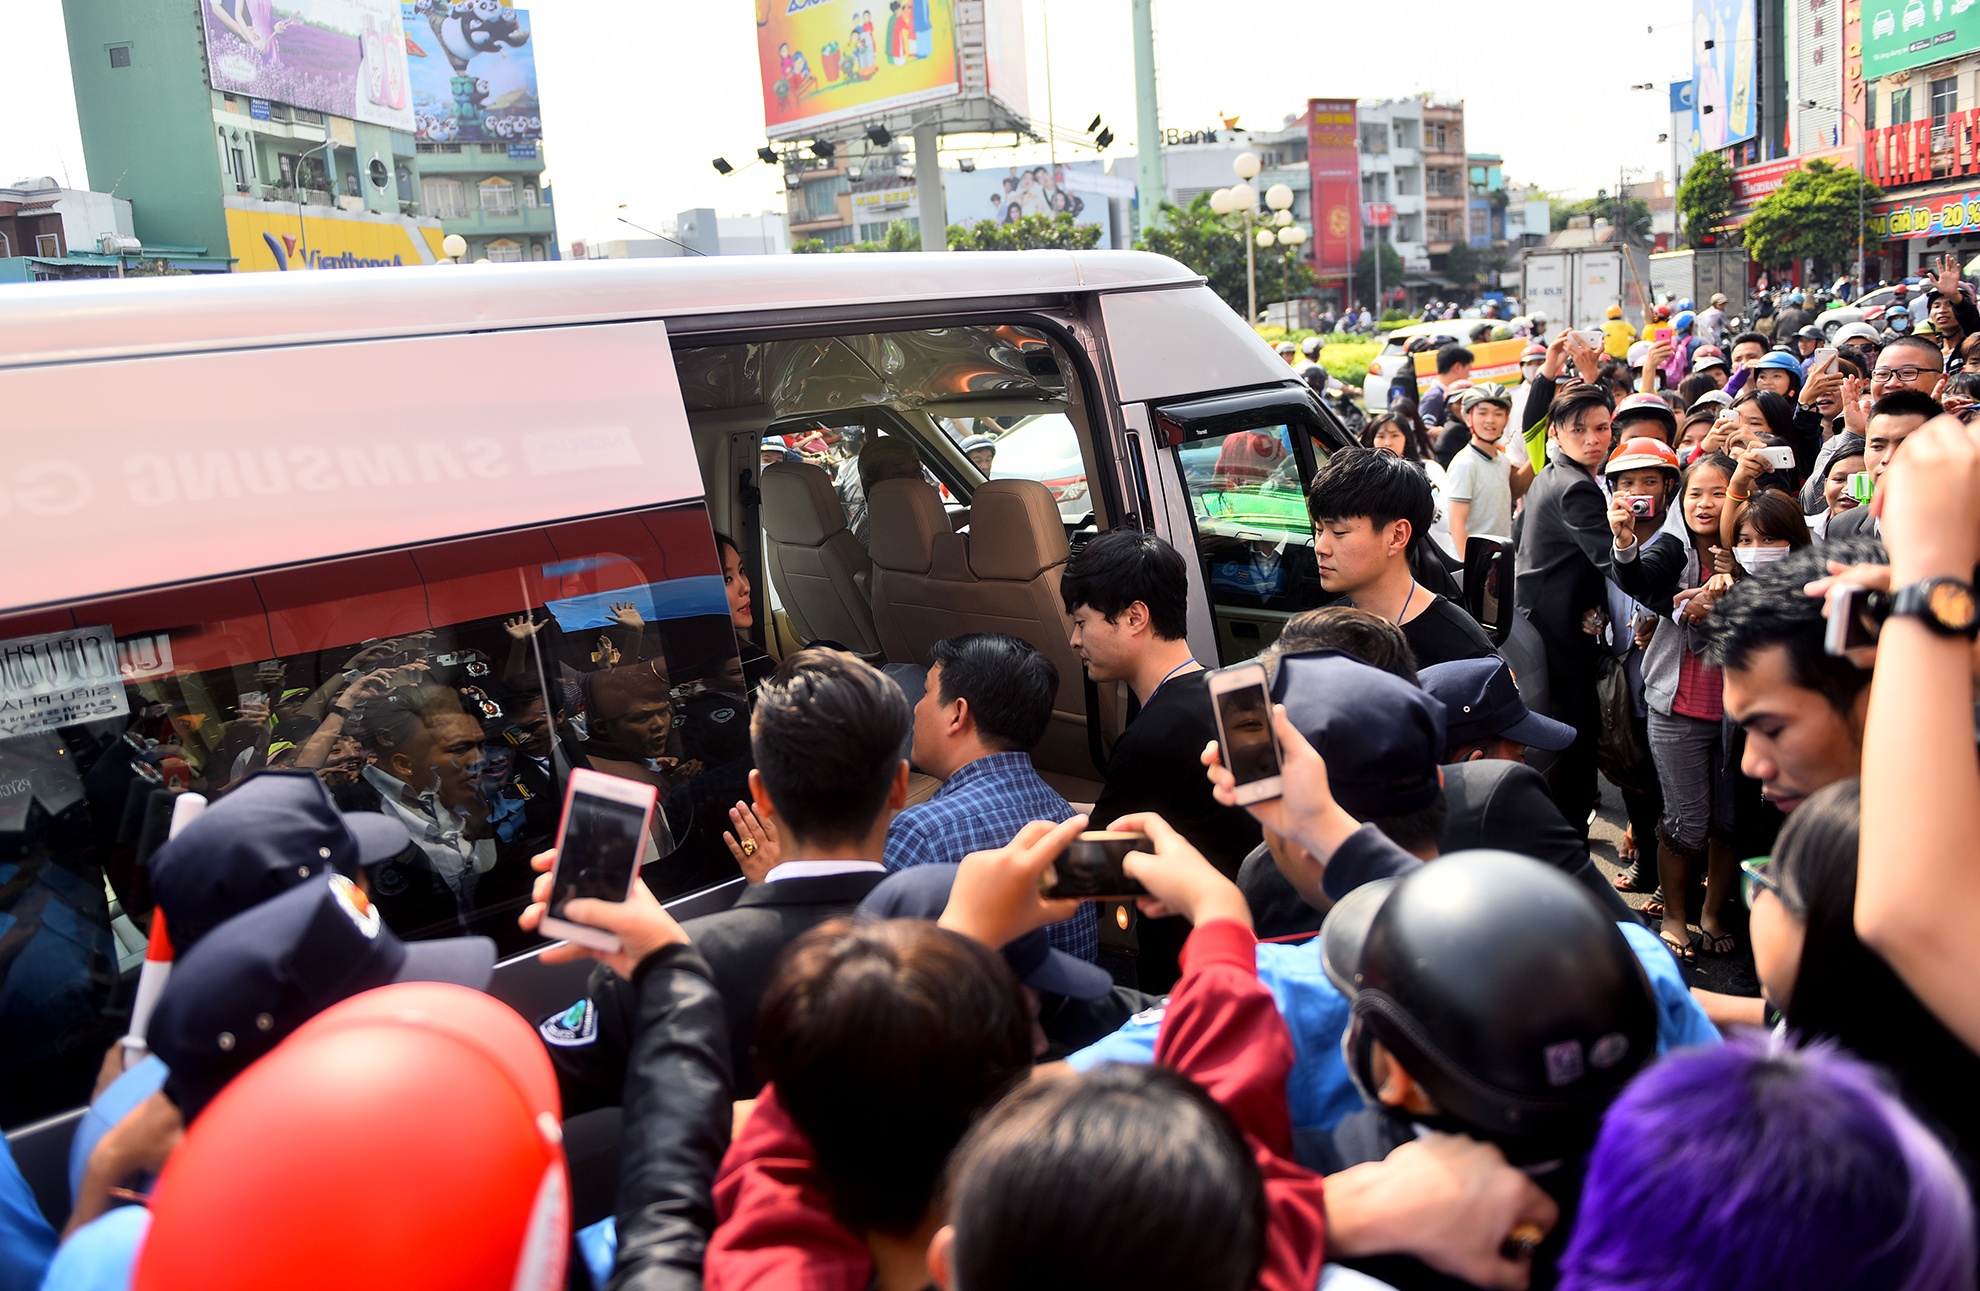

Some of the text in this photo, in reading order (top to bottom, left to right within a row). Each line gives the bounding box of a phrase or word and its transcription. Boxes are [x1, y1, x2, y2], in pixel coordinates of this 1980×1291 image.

[1865, 117, 1933, 188] KINH
[1914, 209, 1930, 232] 10
[1943, 205, 1964, 228] 20
